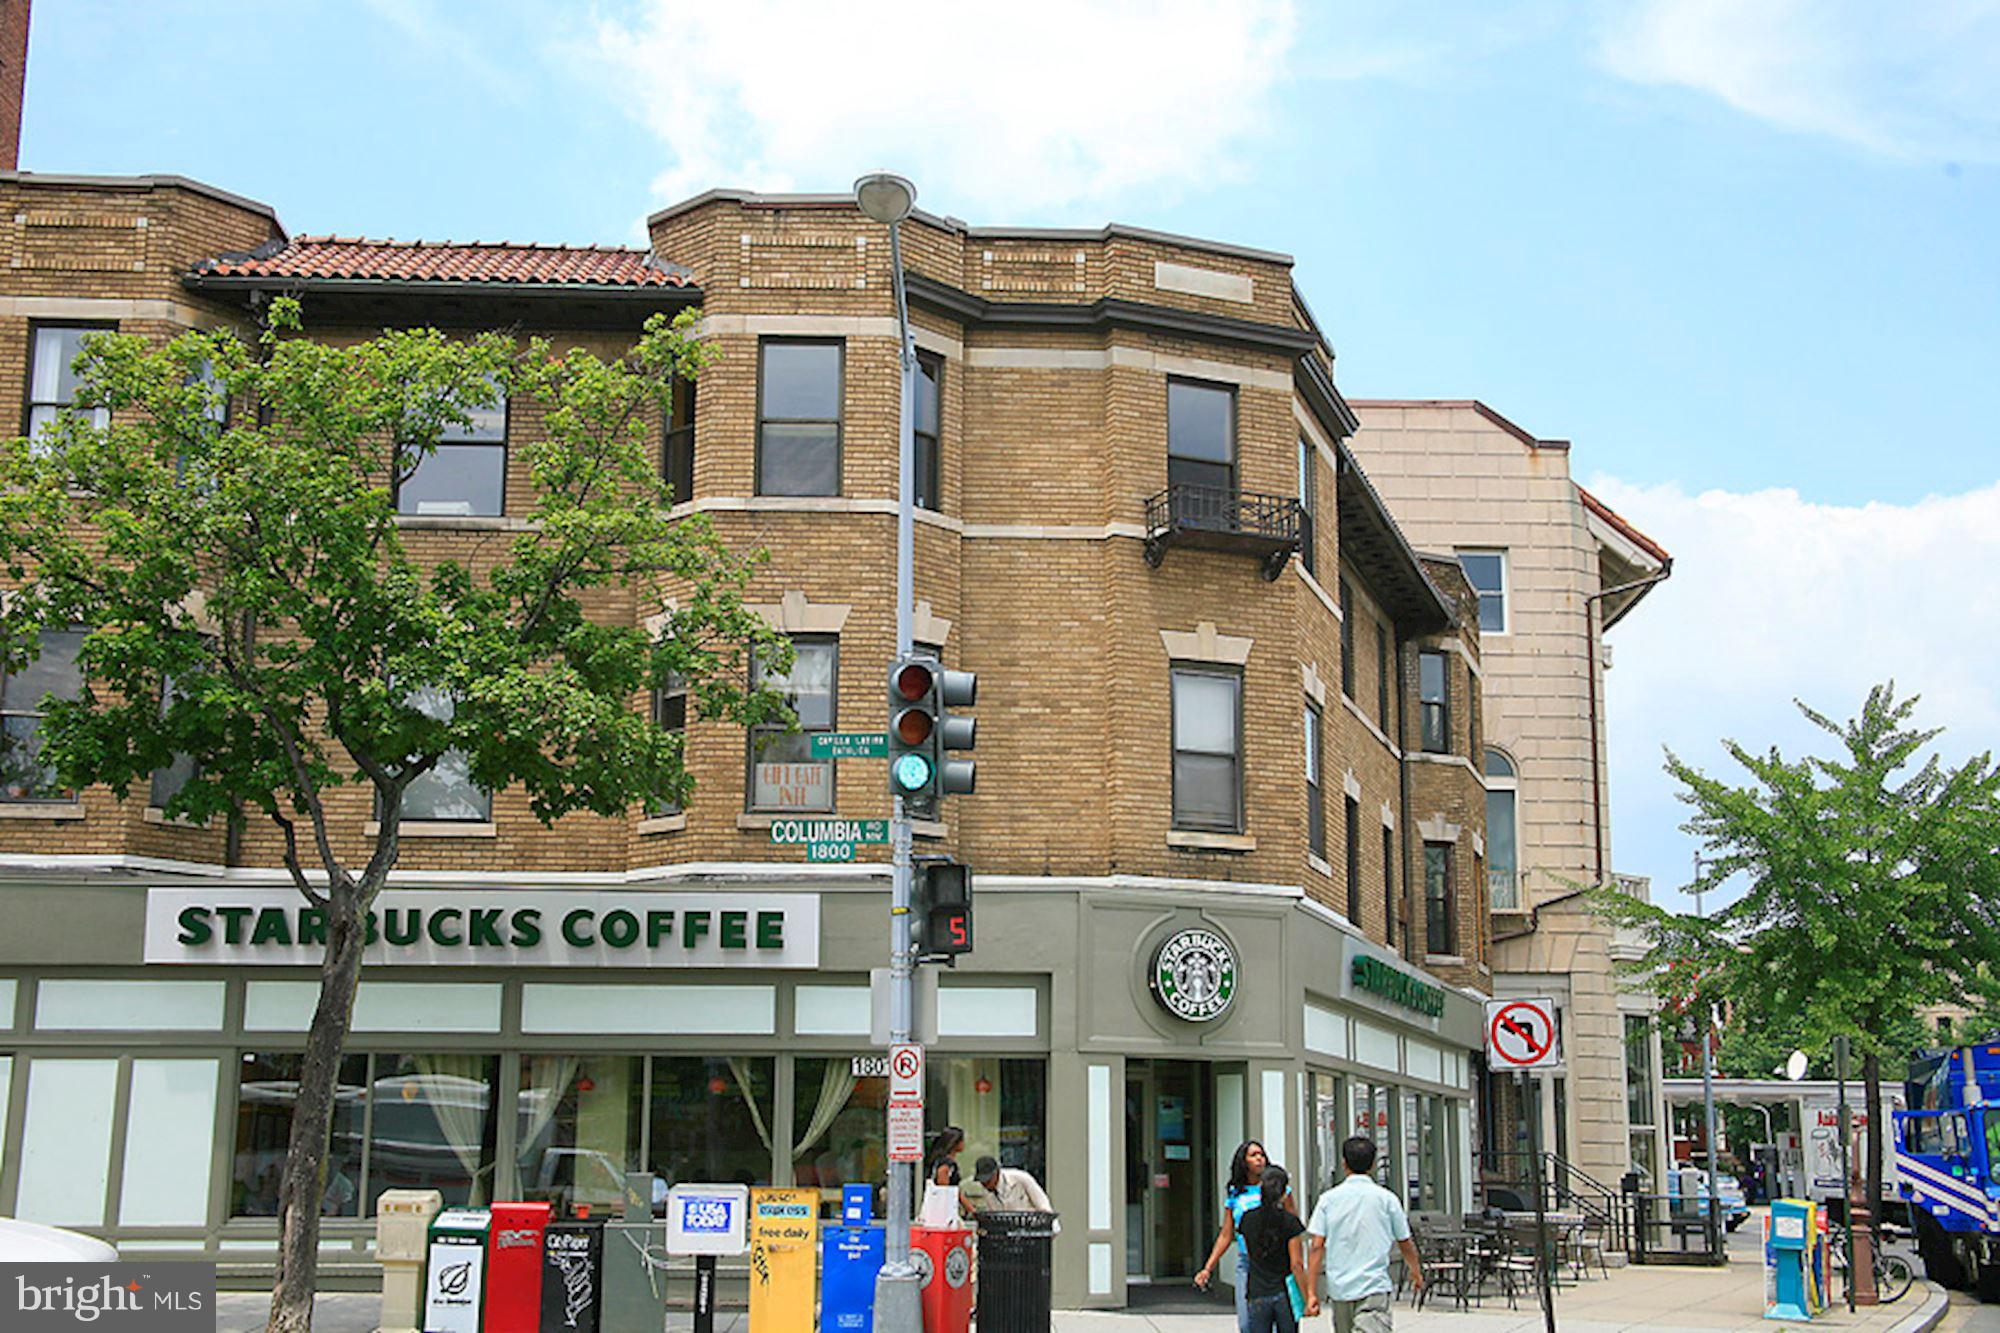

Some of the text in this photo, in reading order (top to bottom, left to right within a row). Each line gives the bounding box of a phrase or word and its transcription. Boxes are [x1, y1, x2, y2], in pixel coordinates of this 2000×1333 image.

[772, 821, 862, 842] COLUMBIA
[811, 844, 850, 859] 1800
[562, 909, 785, 949] COFFEE
[949, 916, 966, 945] 5
[1161, 934, 1233, 974] STARBUCKS
[1169, 991, 1226, 1017] COFFEE
[699, 1203, 727, 1216] USA
[759, 1205, 807, 1218] express
[685, 1214, 728, 1229] TODAY
[759, 1226, 810, 1240] free daily
